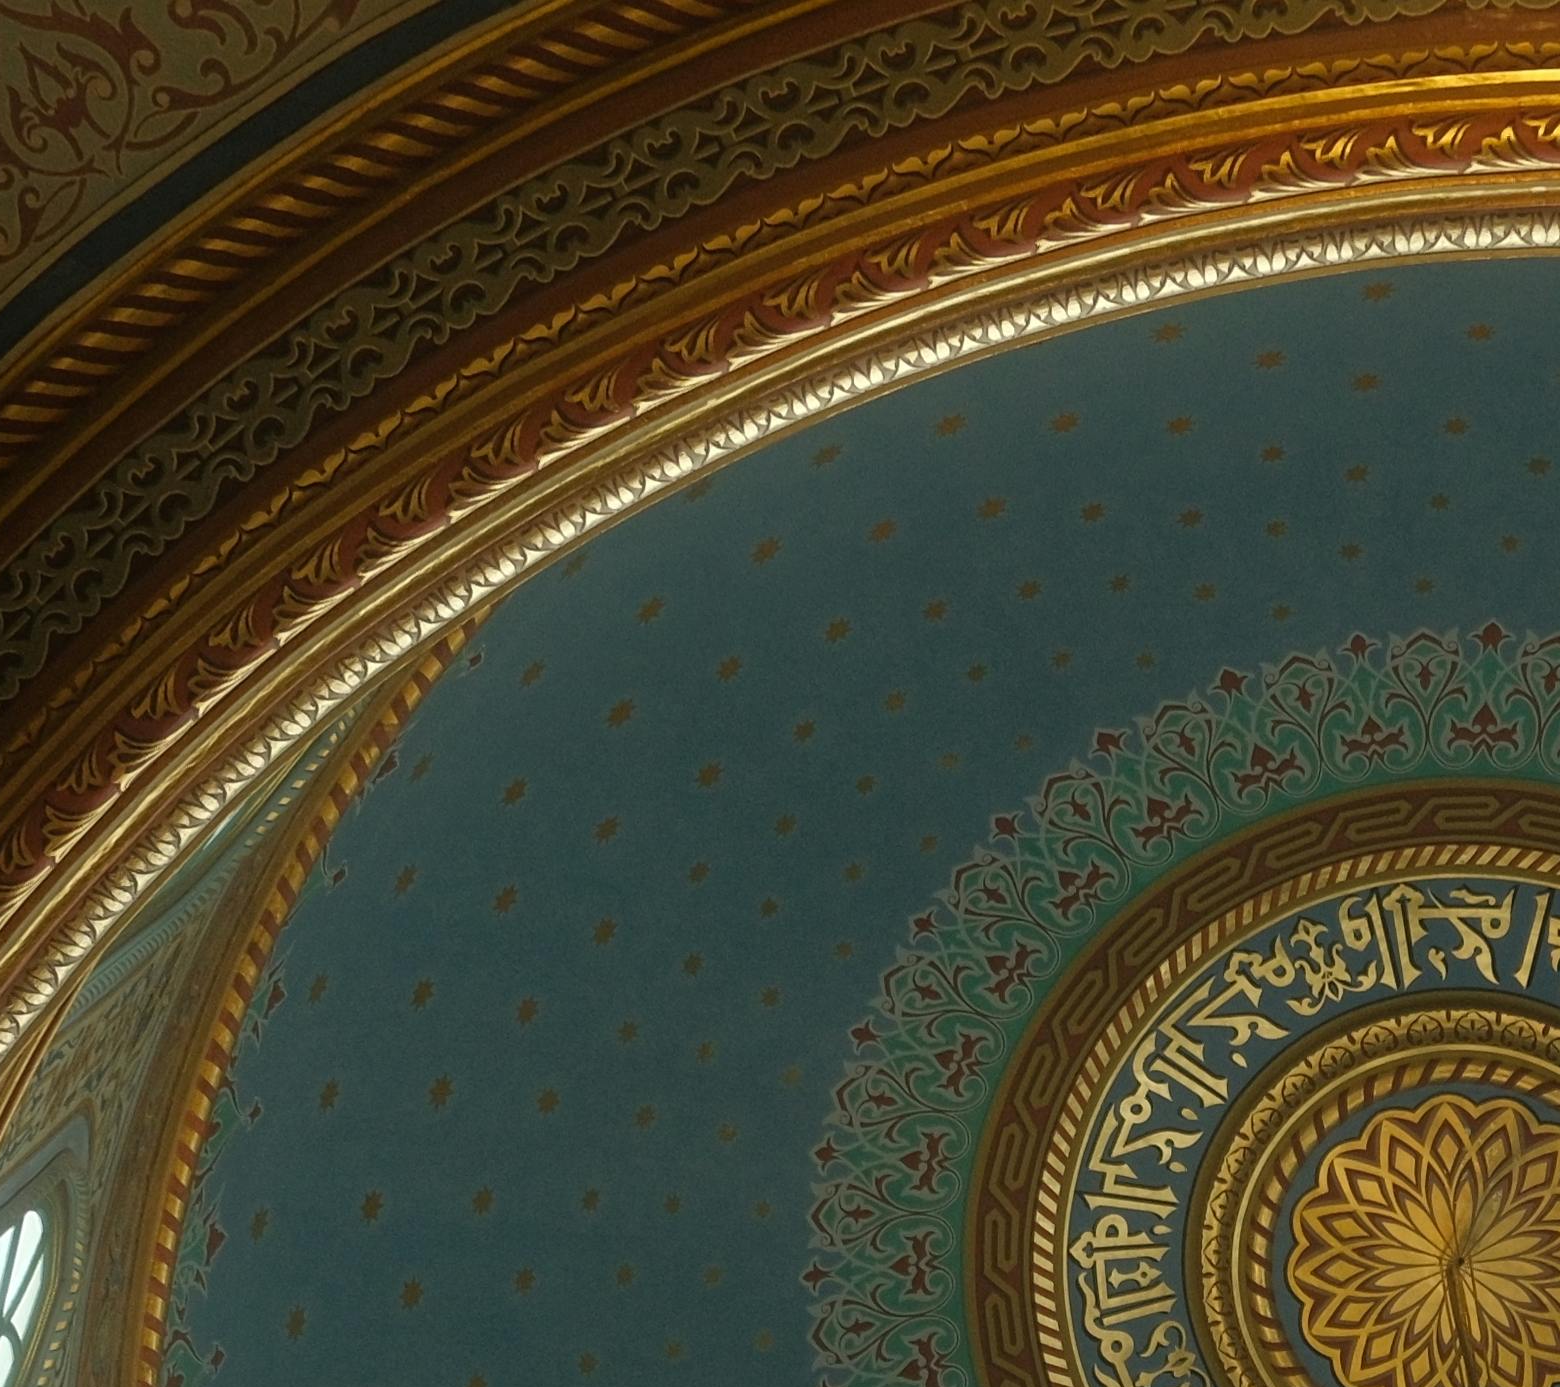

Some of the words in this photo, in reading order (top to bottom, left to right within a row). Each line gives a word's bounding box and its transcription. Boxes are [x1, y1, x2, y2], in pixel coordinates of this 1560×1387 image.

[1348, 883, 1514, 990] والنجم
[1150, 936, 1296, 1107] الرحيم
[1088, 1032, 1204, 1217] الرحمن
[1069, 1214, 1176, 1326] الله
